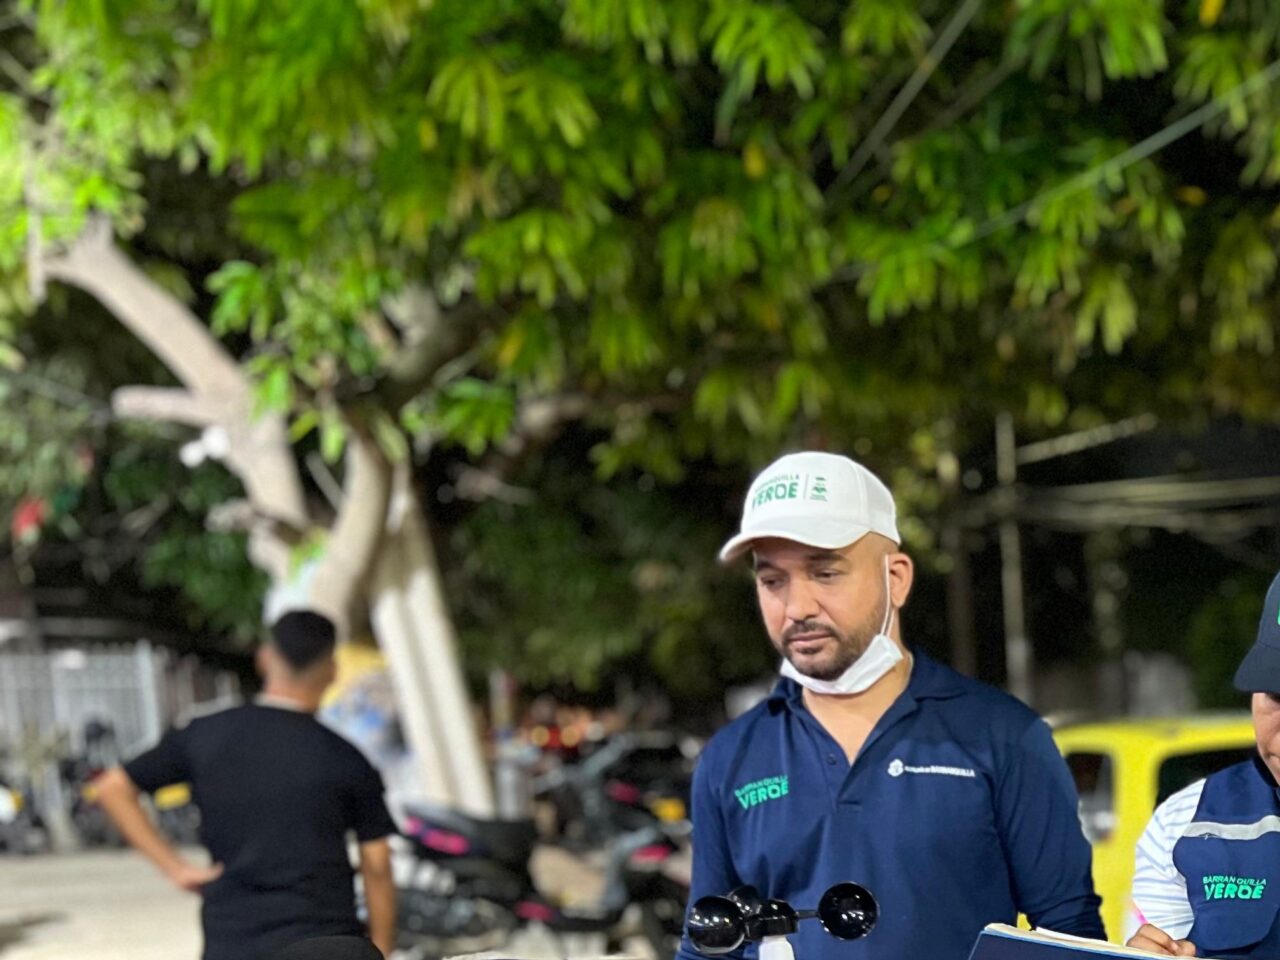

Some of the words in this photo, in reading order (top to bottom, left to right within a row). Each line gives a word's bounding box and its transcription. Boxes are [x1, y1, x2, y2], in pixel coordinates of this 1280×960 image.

[738, 781, 789, 810] VERDE
[1202, 875, 1267, 886] BARRANQUILLA
[1204, 883, 1265, 901] VERDE
